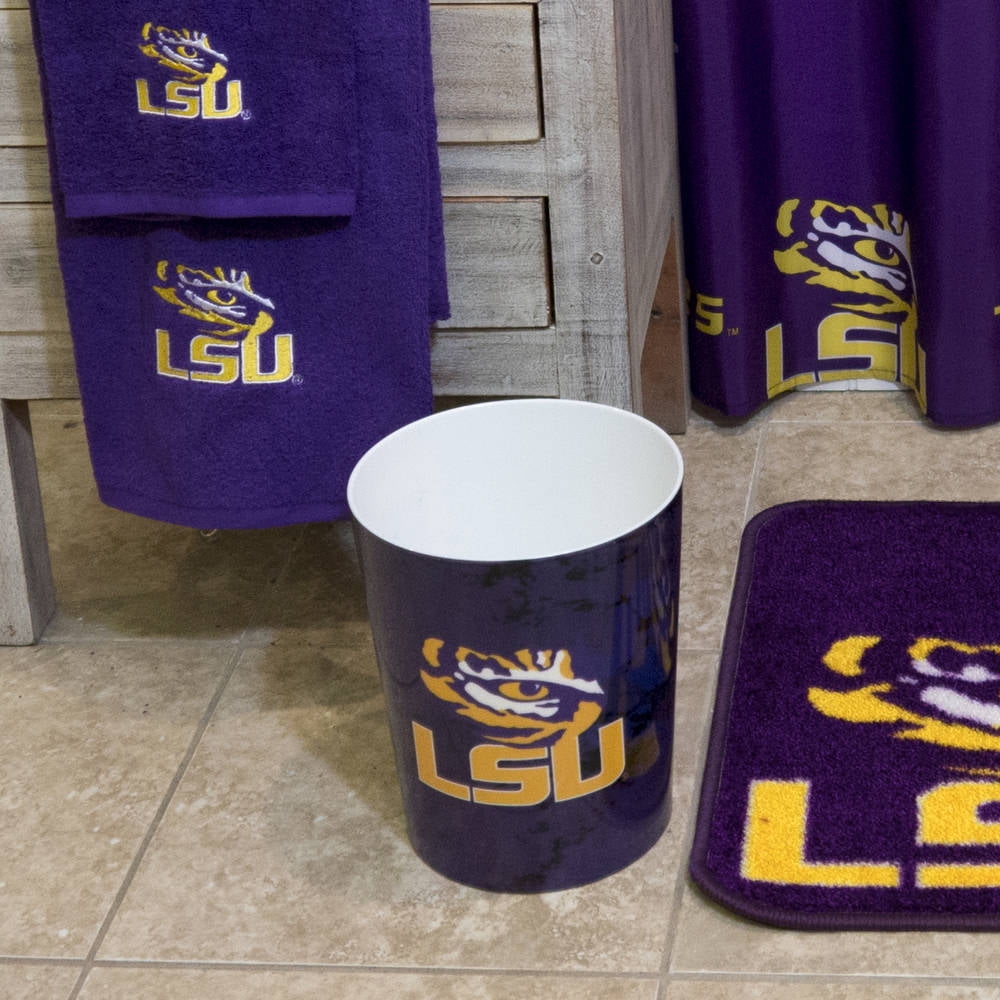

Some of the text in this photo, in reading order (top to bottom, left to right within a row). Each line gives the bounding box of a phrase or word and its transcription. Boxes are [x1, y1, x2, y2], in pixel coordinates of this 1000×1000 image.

[136, 78, 243, 119] LSU
[155, 328, 295, 384] LSU
[765, 312, 928, 414] LSU
[411, 716, 627, 807] LSU
